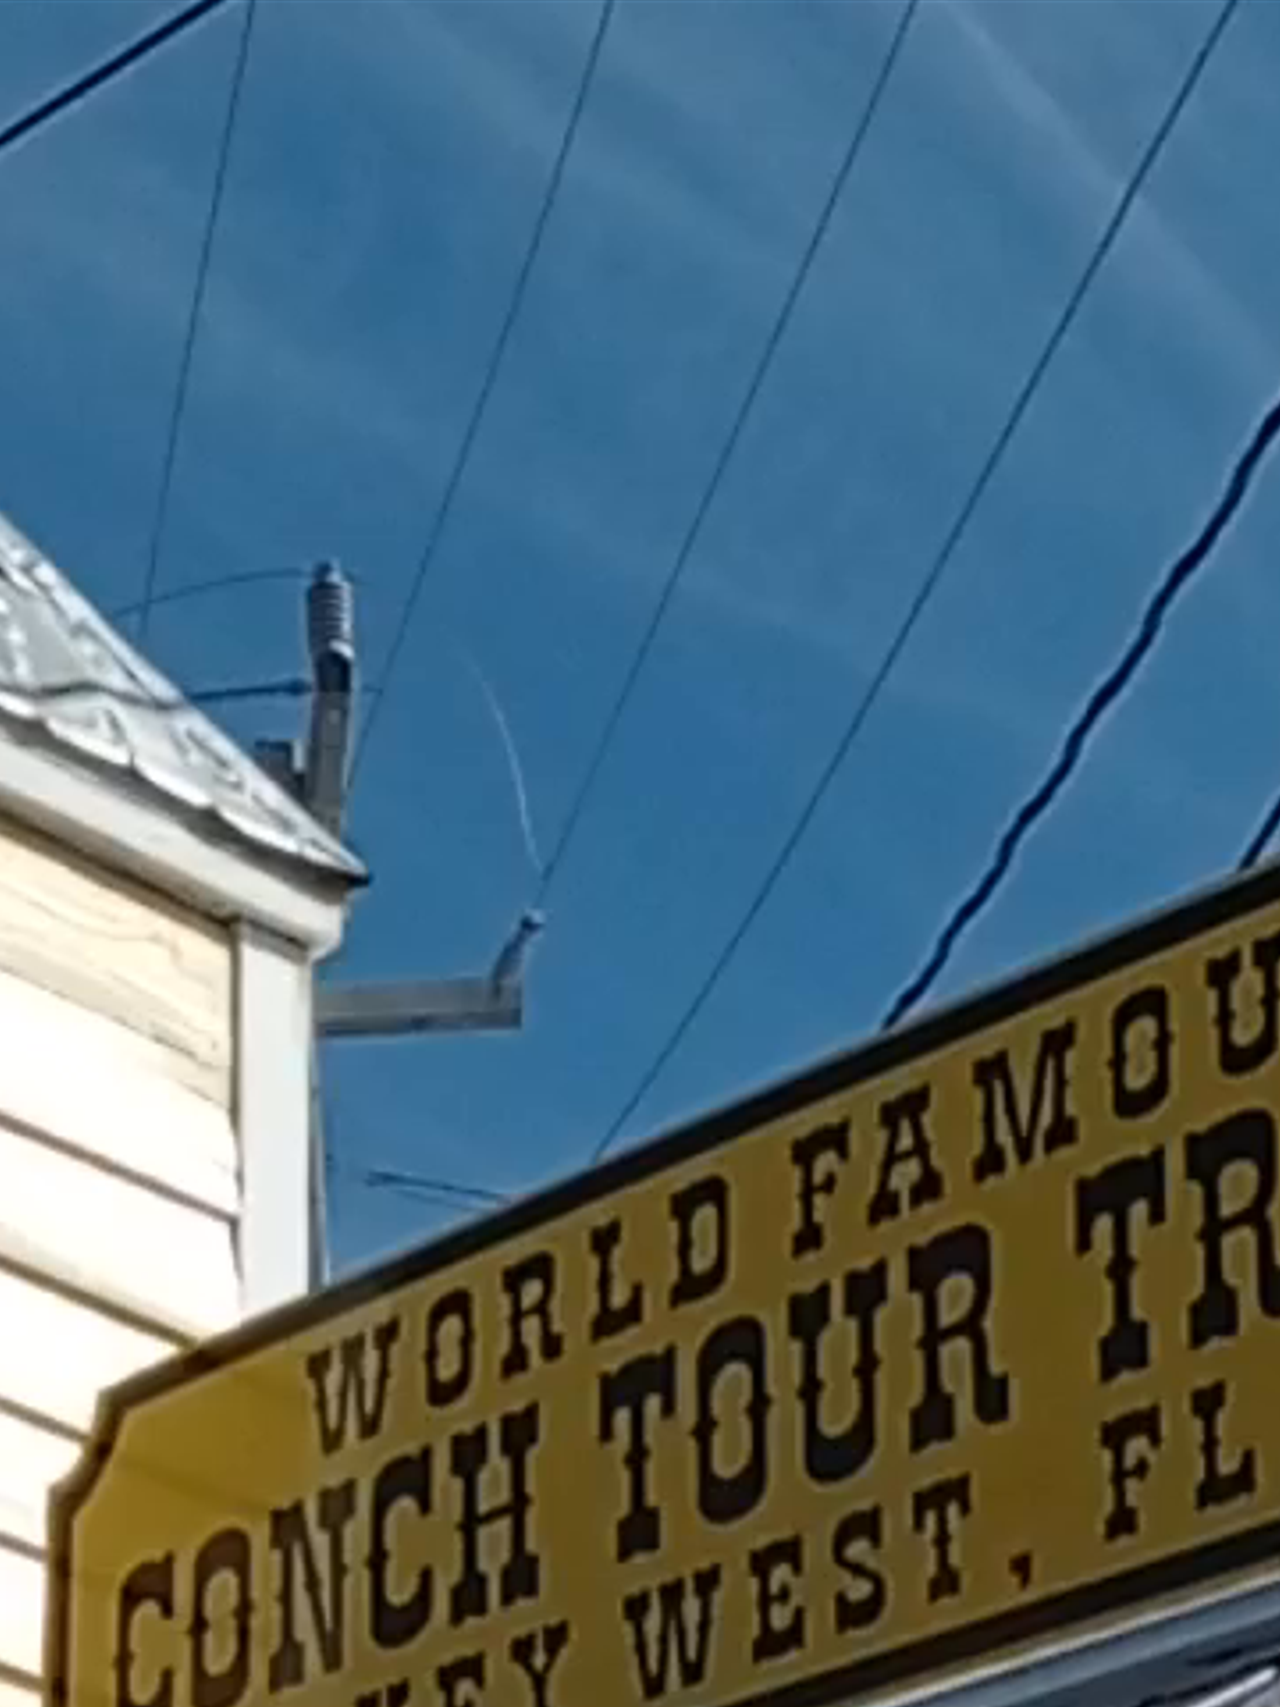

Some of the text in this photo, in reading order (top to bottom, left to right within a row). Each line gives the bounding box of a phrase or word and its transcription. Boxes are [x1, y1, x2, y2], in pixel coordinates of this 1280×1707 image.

[307, 1160, 733, 1454] WORLD
[598, 1222, 1012, 1567] TOUR
[624, 1495, 1036, 1704] WEST,
